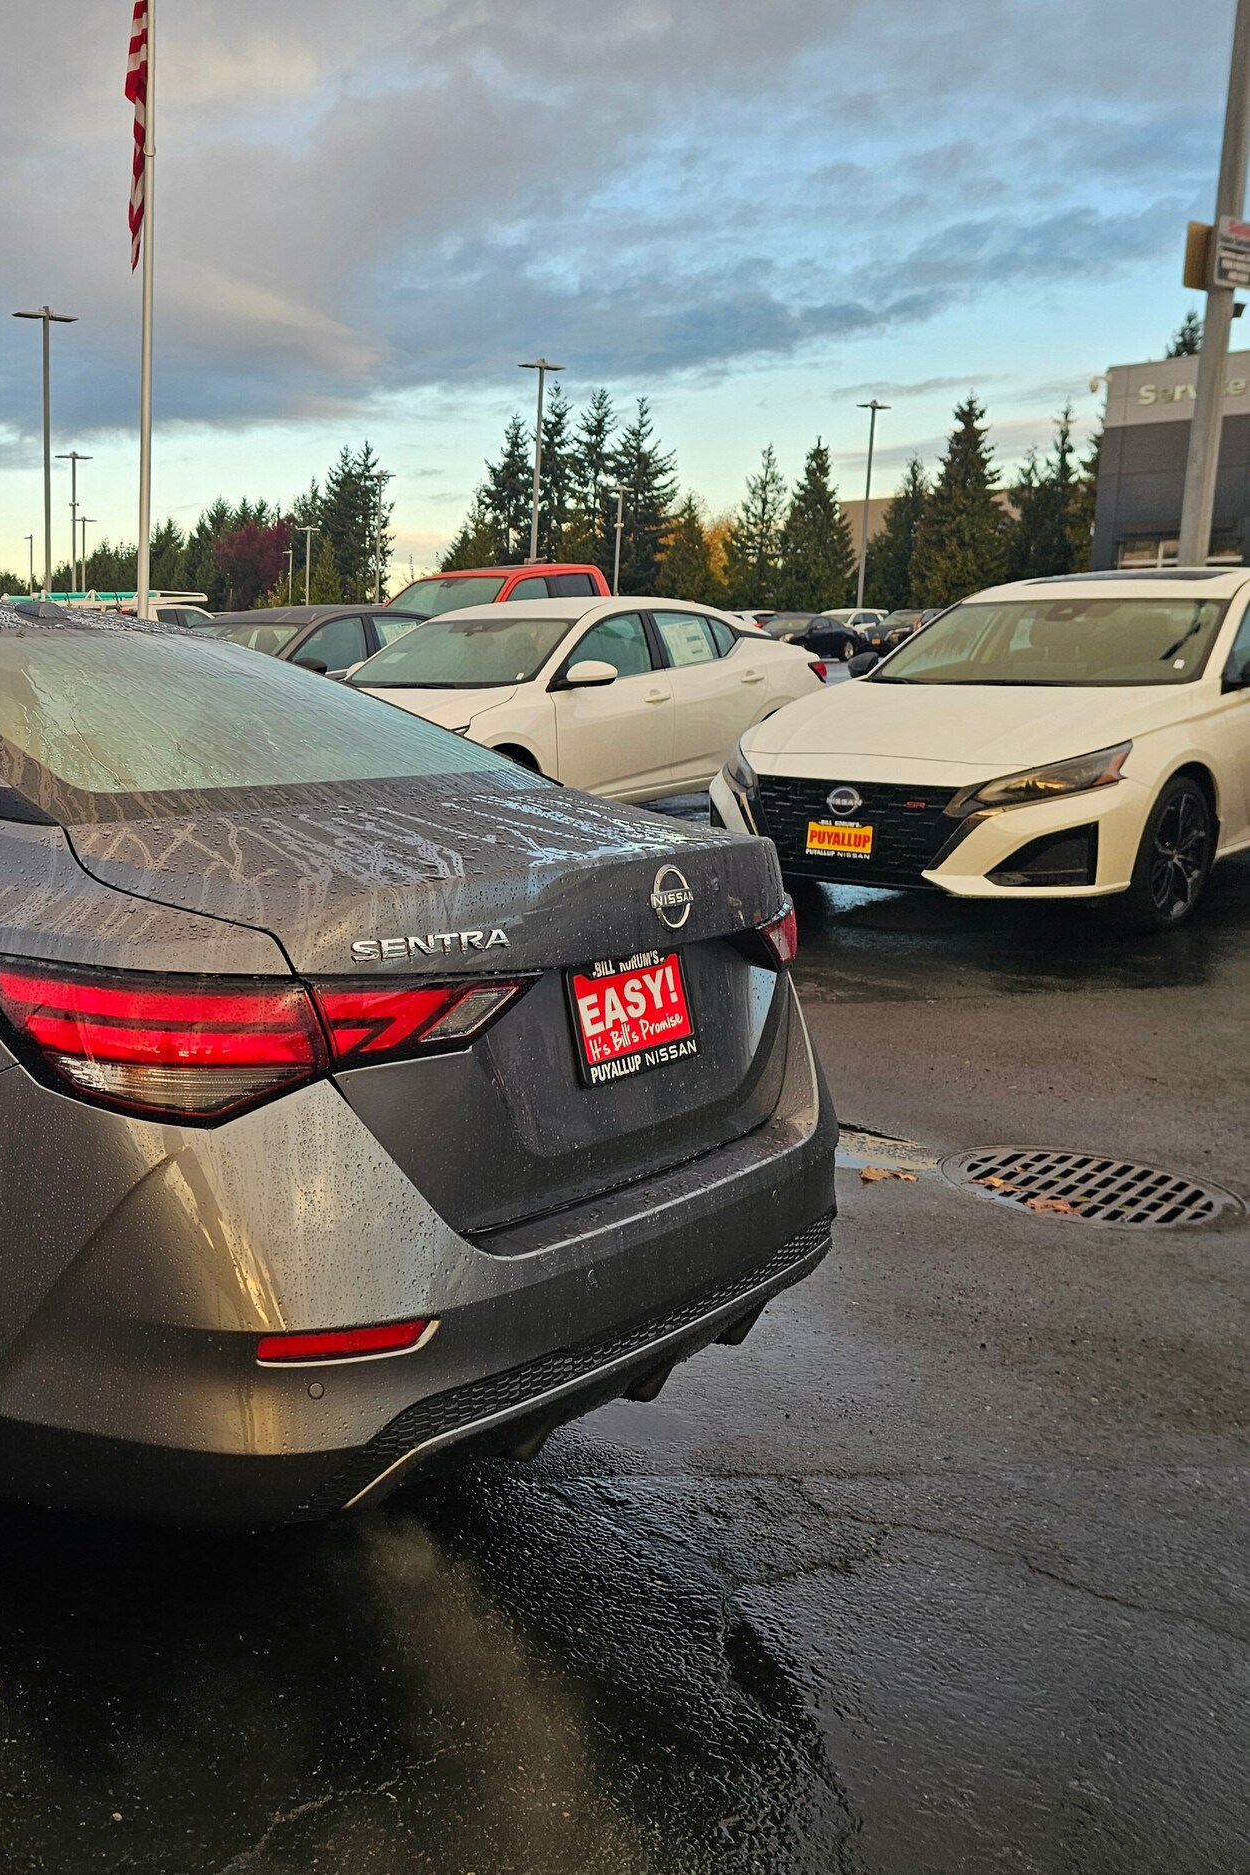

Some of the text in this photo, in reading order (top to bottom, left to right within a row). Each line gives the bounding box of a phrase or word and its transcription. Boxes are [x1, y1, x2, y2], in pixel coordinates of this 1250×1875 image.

[826, 797, 863, 806] NISSAN
[809, 829, 871, 848] PUYALLUP
[805, 848, 871, 860] PUYALLUP NISSAN
[653, 891, 694, 907] NISSAN
[351, 928, 511, 963] SENTRA
[594, 959, 616, 978] BILL
[578, 965, 679, 1037] EASY!
[589, 1012, 684, 1062] It's Bill's Promise
[590, 1040, 698, 1084] PUYALLUP NISSAN
